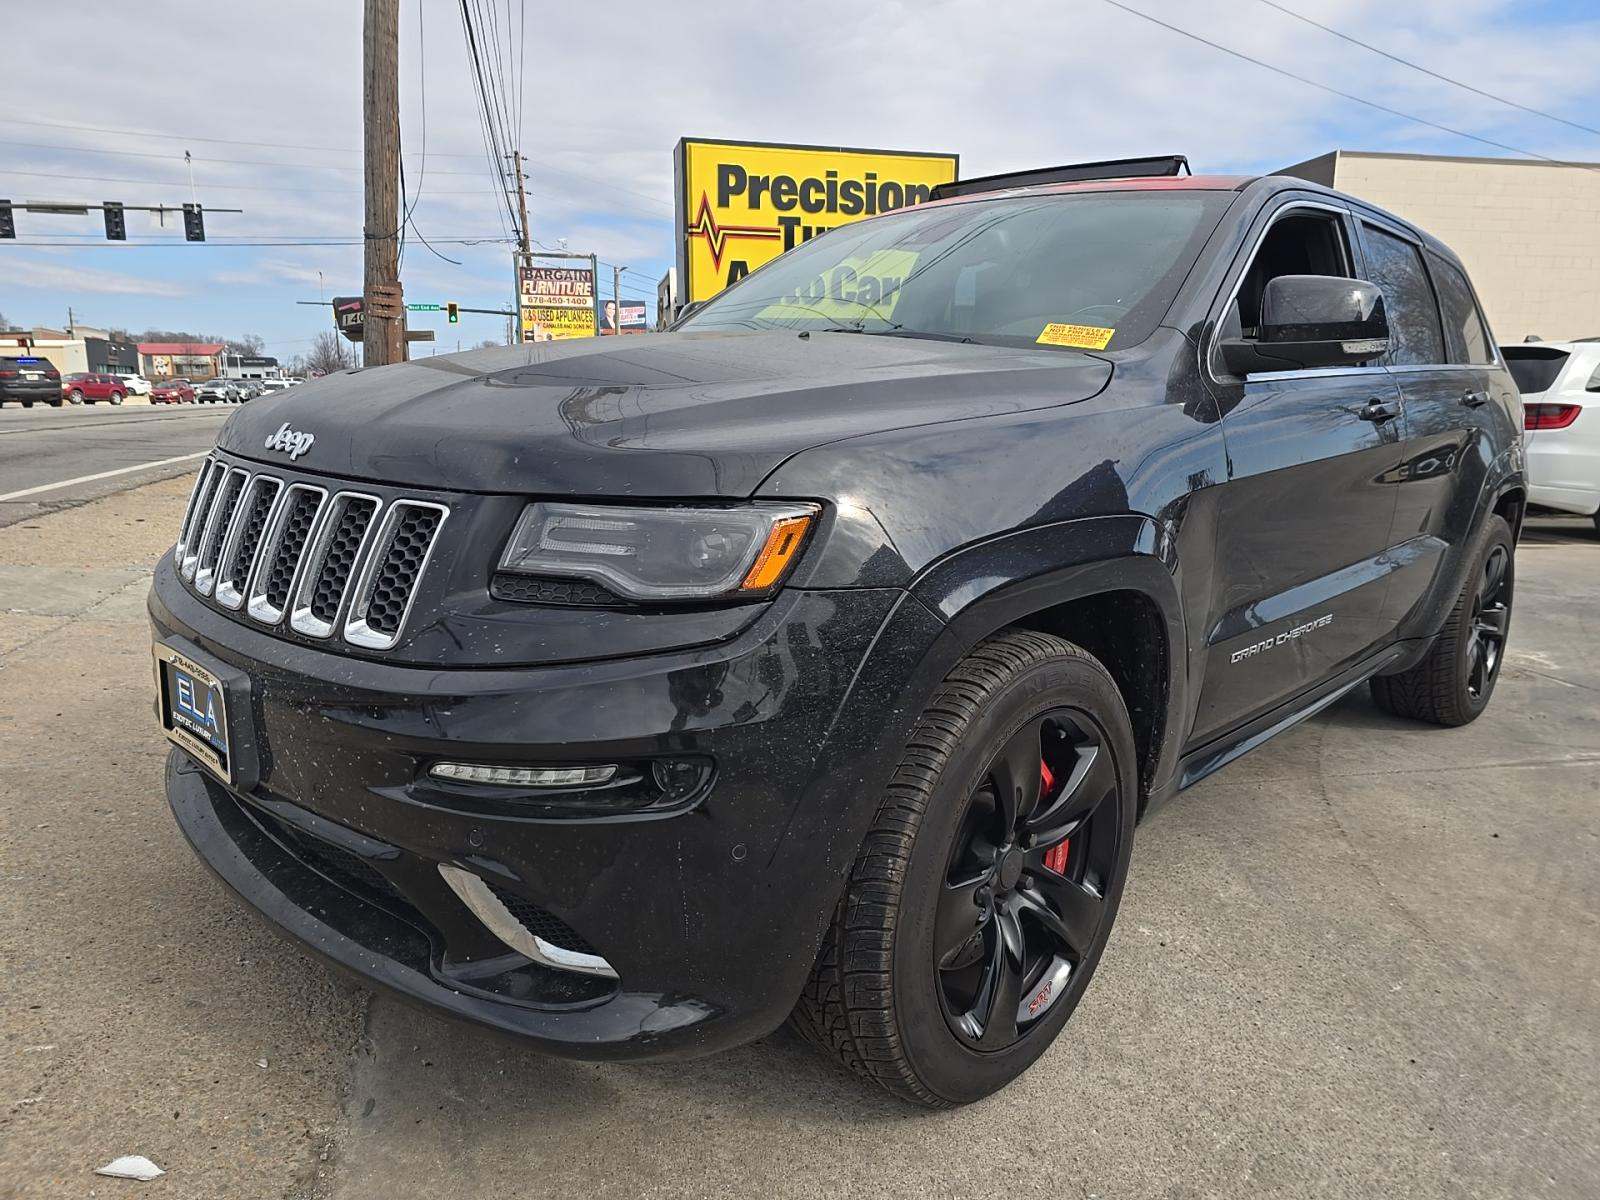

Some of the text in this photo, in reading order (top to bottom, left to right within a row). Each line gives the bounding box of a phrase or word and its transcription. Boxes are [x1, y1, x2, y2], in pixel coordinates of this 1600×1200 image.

[522, 280, 592, 296] FURNITURE
[524, 269, 588, 281] BARGAIN
[537, 309, 554, 321] USED
[555, 309, 594, 323] APPLIANCES
[264, 422, 315, 461] Jeep
[1230, 613, 1333, 664] GRAND CHEROKEE
[1028, 980, 1053, 1016] SRT
